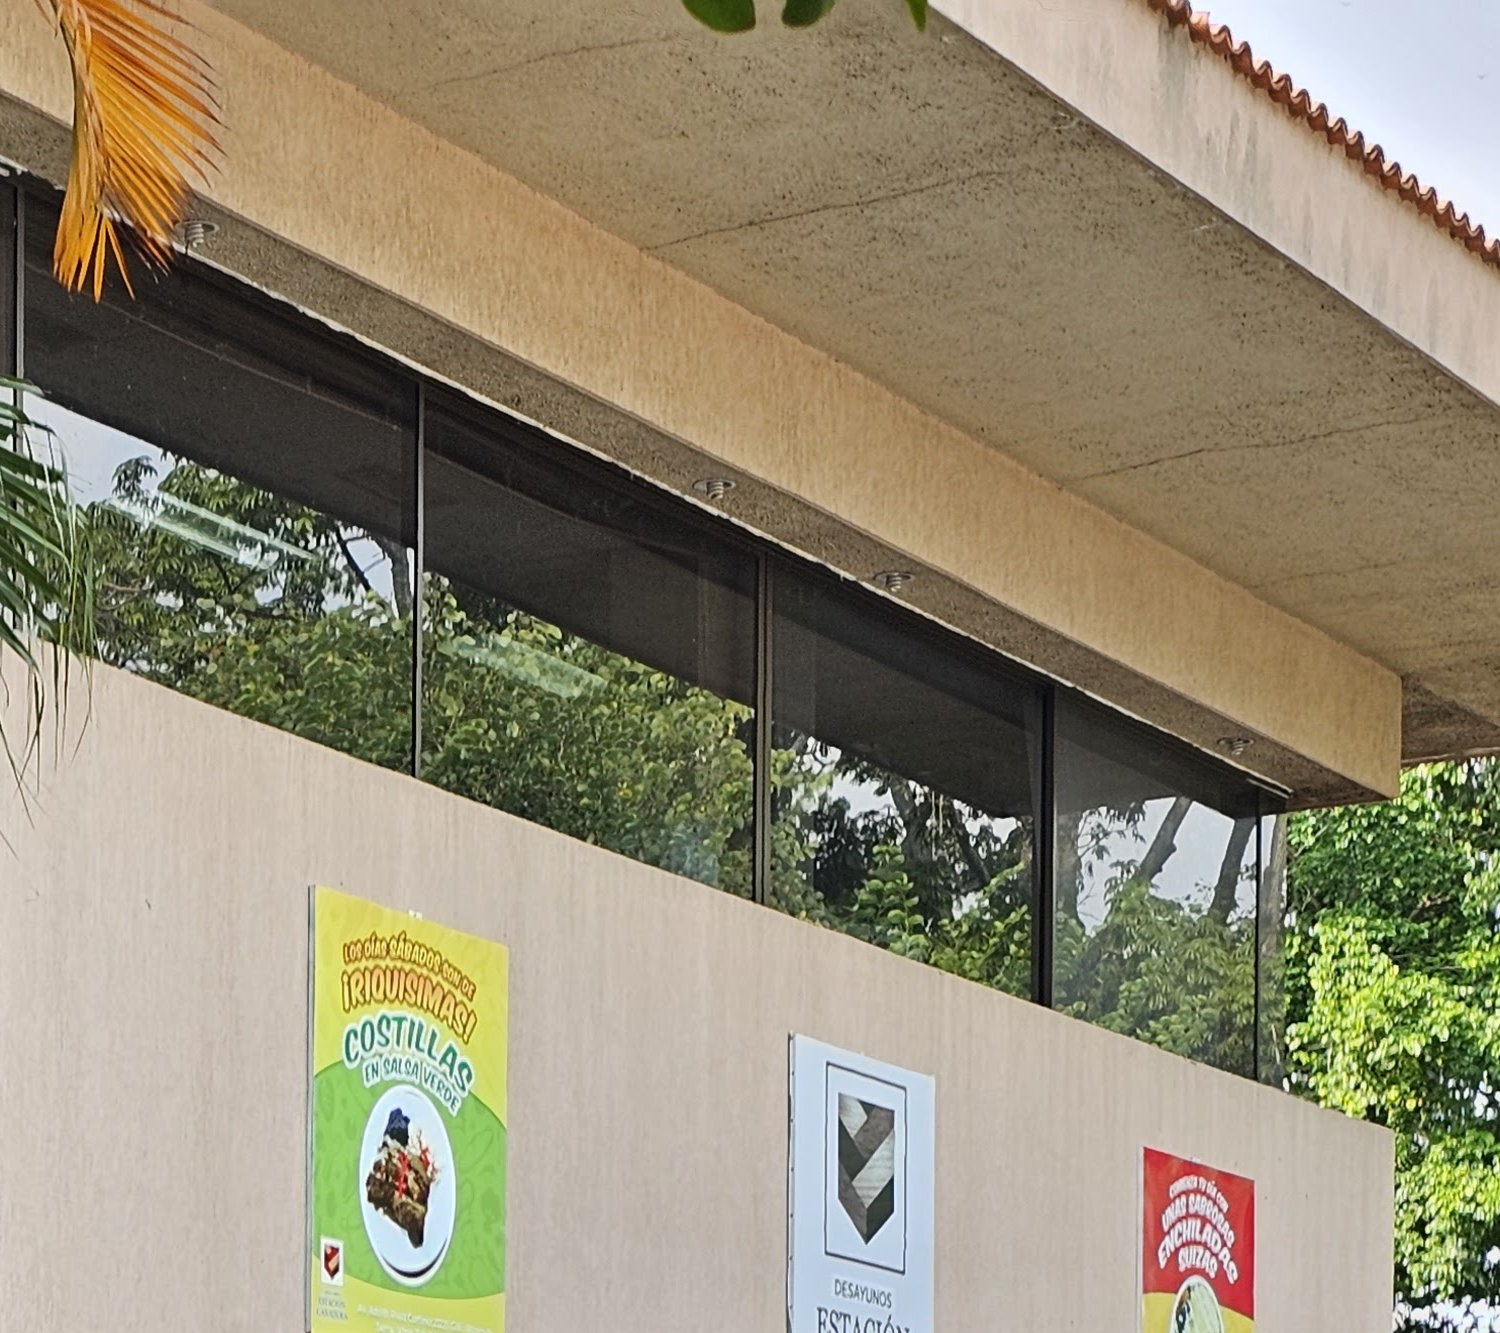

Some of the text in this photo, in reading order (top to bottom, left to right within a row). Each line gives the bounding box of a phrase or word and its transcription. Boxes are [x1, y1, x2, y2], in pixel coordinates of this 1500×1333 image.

[343, 930, 476, 1001] LOS DÍAS SÁBADOS SON DE
[341, 964, 477, 1045] ¡RIQUISIMAS!
[345, 1014, 473, 1092] COSTILLAS
[365, 1057, 460, 1111] EN SALSA VERDE
[1162, 1193, 1235, 1248] UNAS SABROSAS
[1158, 1218, 1238, 1285] ENCHILADAS
[1178, 1245, 1218, 1279] SUIZAS
[835, 1279, 892, 1309] DESAYUNOS
